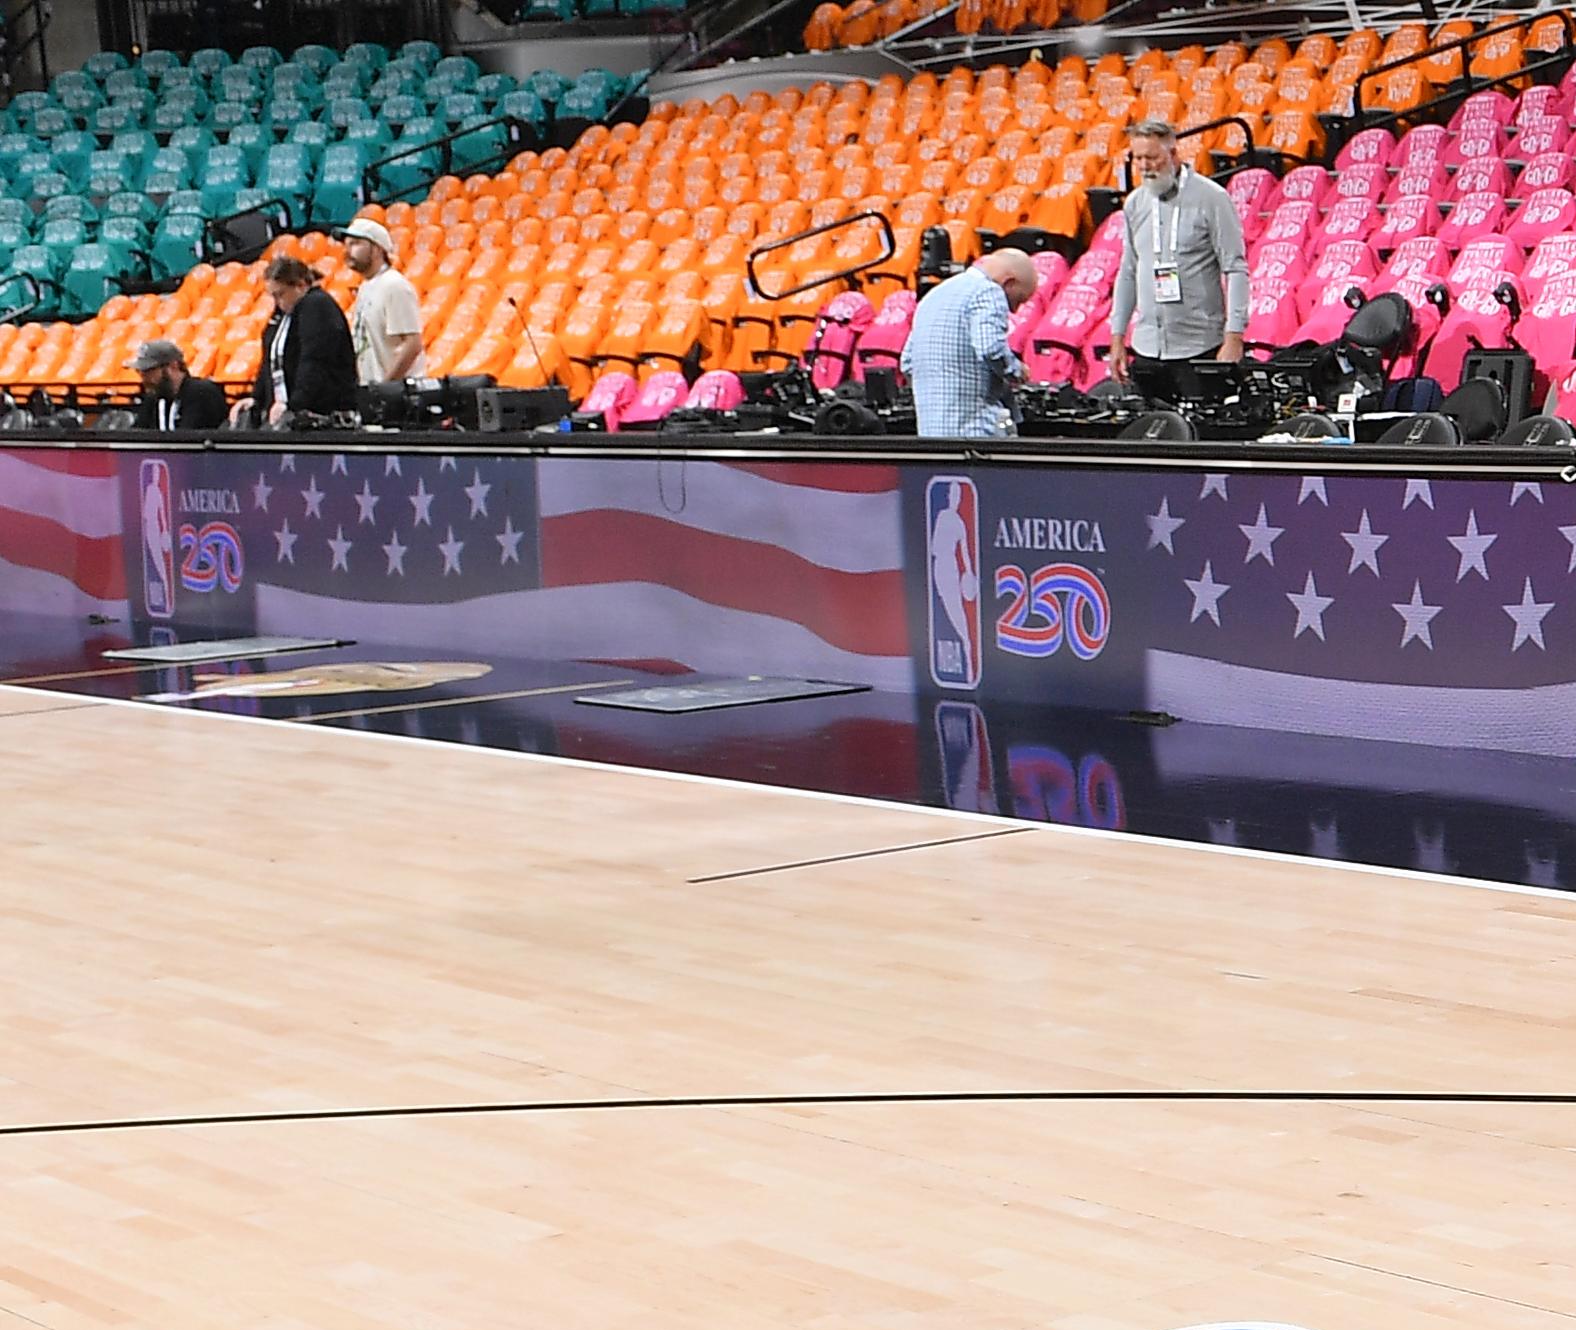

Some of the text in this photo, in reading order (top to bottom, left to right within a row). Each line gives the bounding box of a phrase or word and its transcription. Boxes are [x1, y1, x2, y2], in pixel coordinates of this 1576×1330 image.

[180, 489, 240, 514] AMERICA
[180, 521, 244, 593] 250
[994, 517, 1106, 552] AMERICA
[995, 563, 1110, 660] 250
